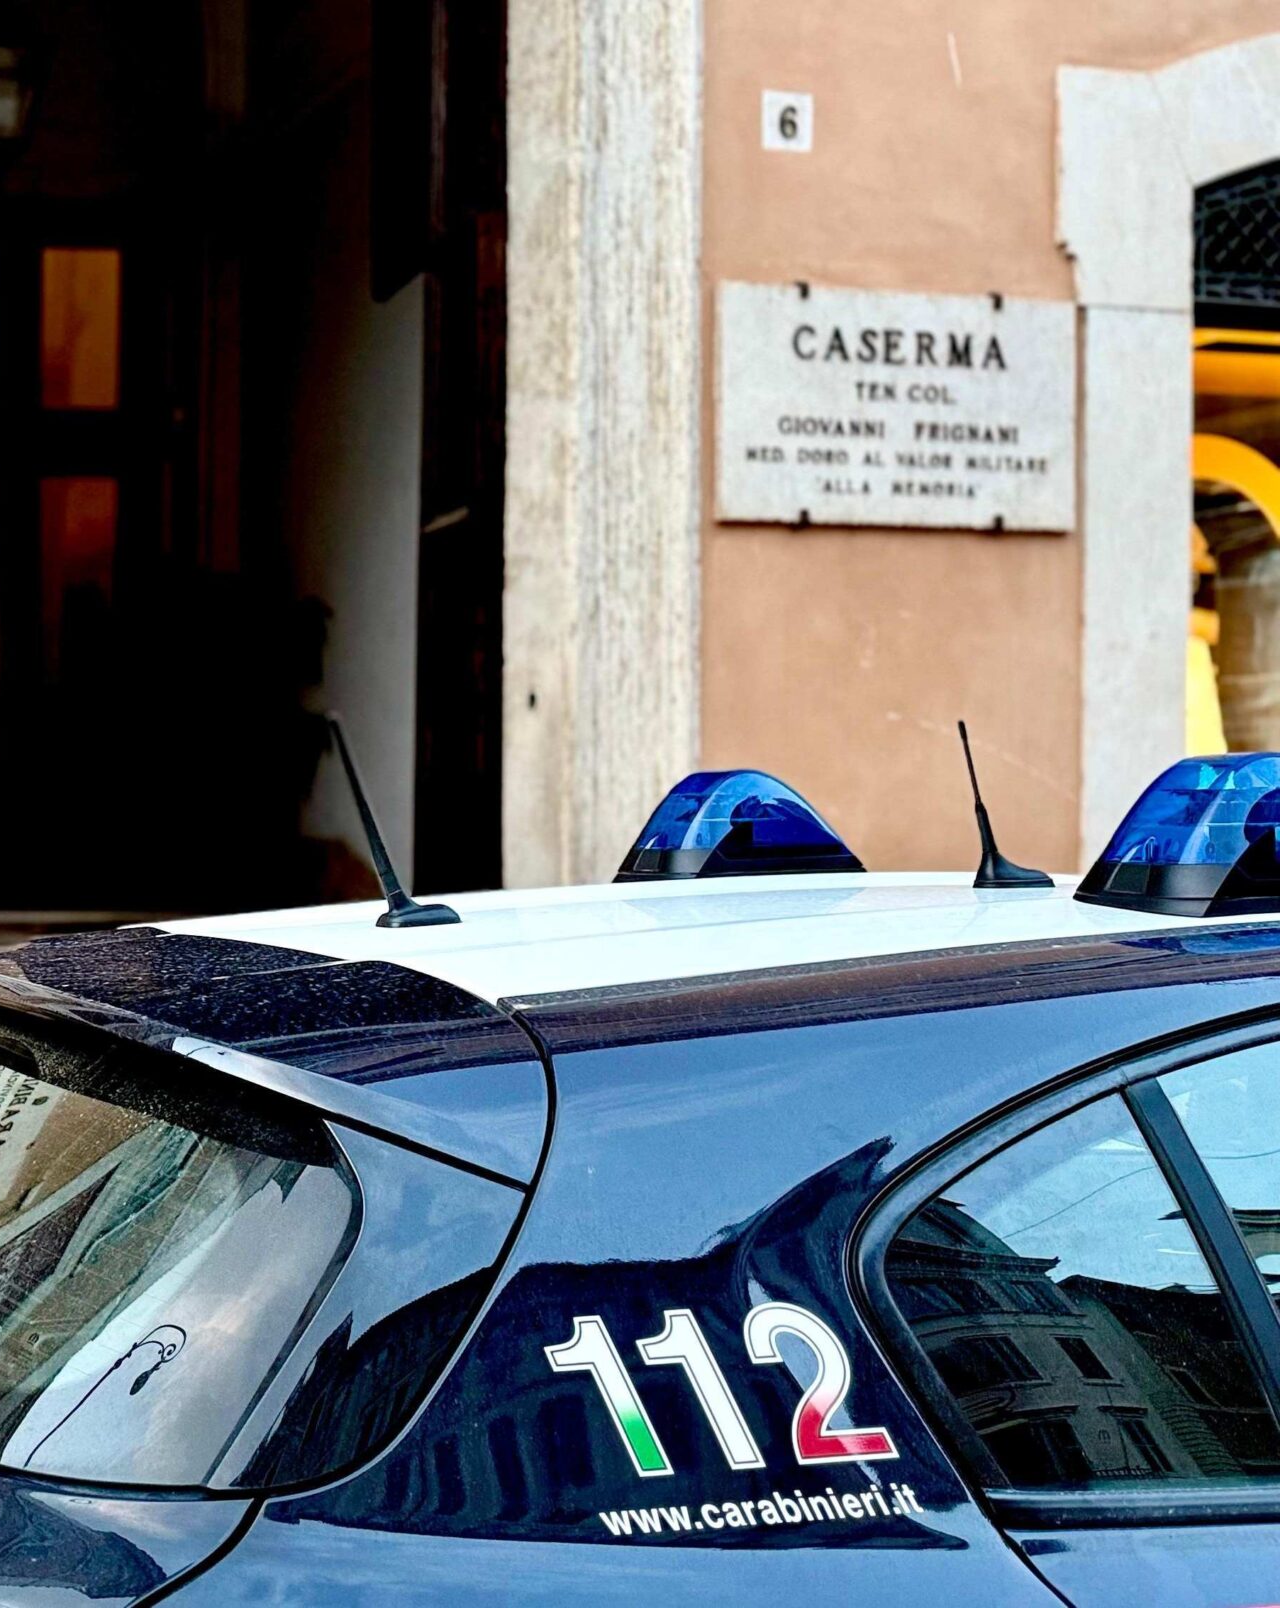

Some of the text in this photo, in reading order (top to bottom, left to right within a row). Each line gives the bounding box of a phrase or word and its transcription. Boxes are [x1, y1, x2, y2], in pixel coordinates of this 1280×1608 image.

[779, 105, 798, 140] 6
[791, 325, 1008, 371] CASERMA
[777, 415, 1019, 445] GIOVANNI FRIGNANI
[863, 451, 886, 468] AL
[543, 1301, 900, 1478] 112
[598, 1482, 924, 1537] www.carabinieri.it
